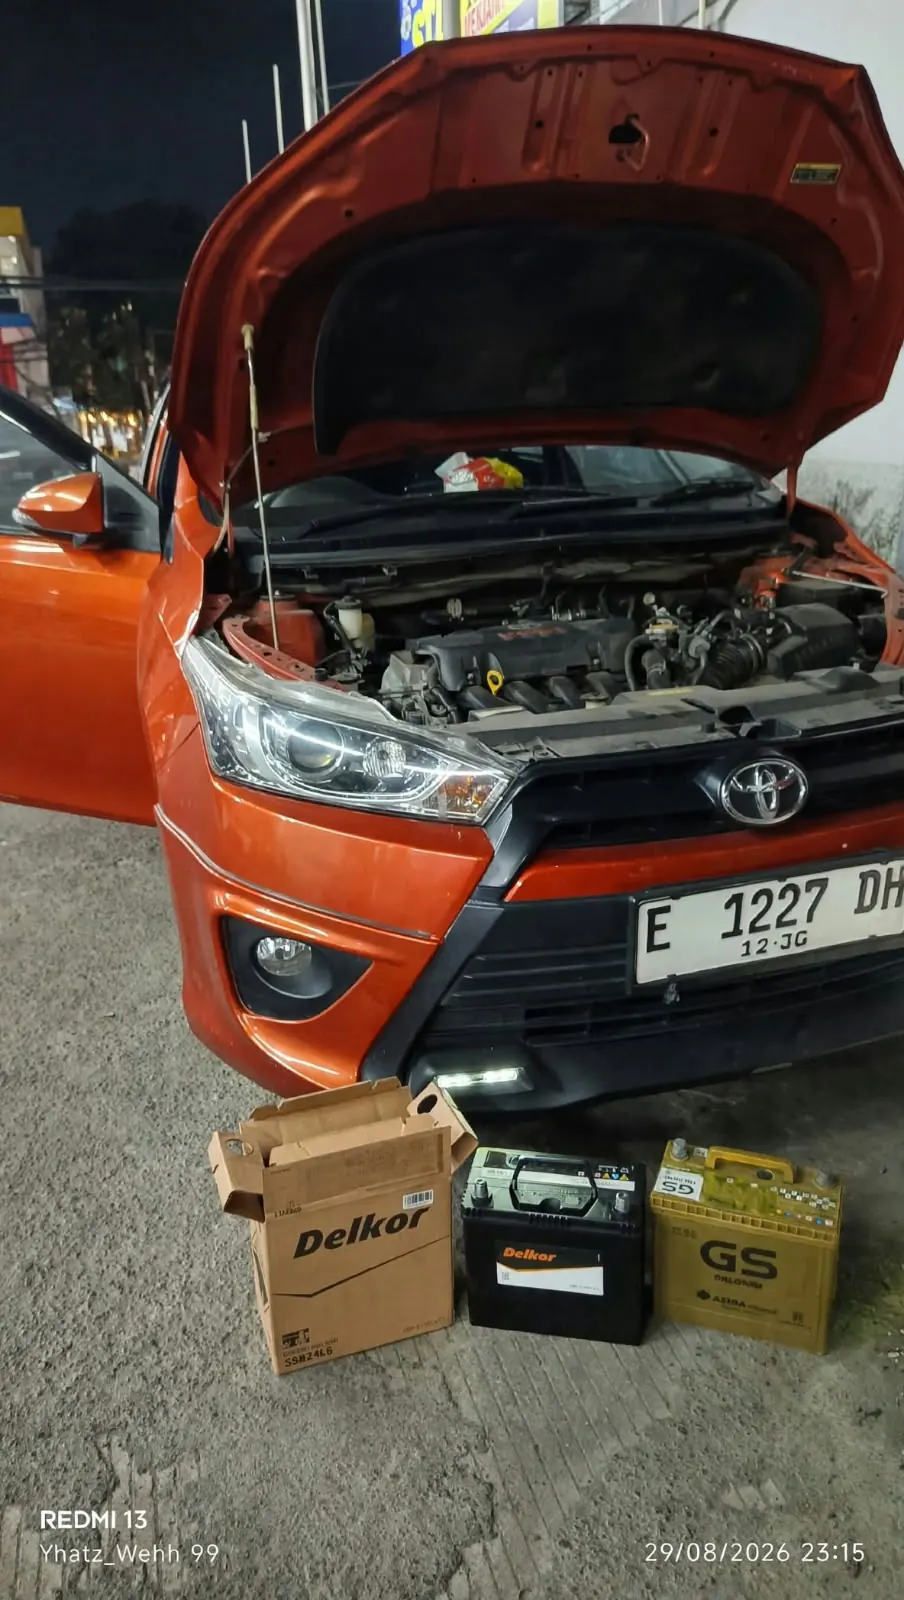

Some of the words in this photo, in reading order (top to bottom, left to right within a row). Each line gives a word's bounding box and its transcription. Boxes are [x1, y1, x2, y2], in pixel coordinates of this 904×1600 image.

[646, 905, 671, 954] E
[721, 878, 829, 940] 1227
[854, 866, 904, 915] DH
[662, 1181, 694, 1195] GS
[293, 1207, 430, 1260] Delkor
[503, 1247, 557, 1262] Delkor
[700, 1240, 778, 1280] GS
